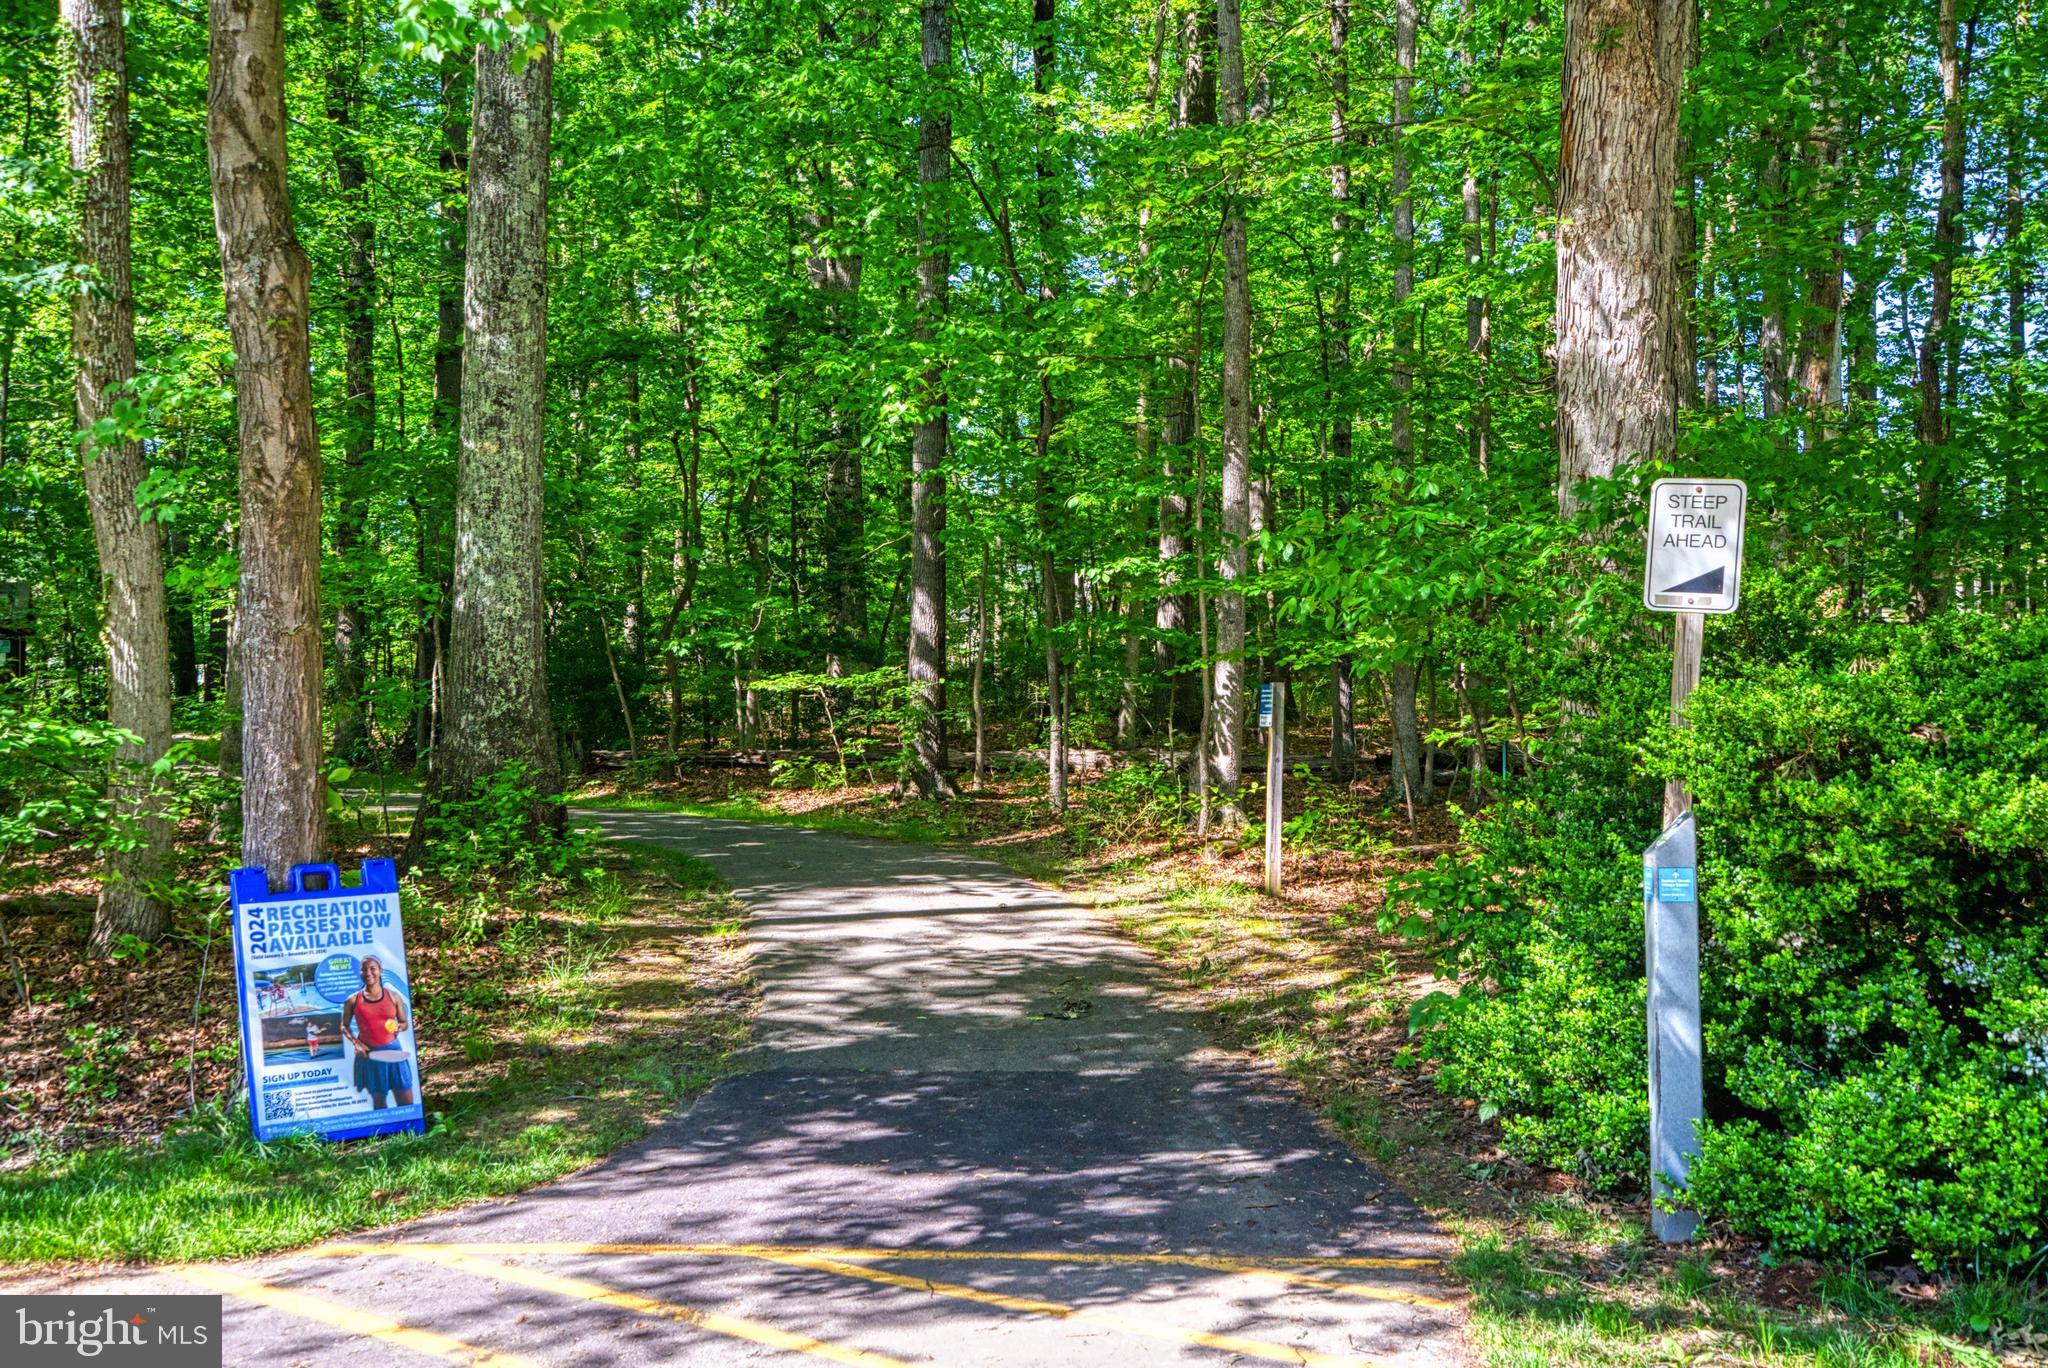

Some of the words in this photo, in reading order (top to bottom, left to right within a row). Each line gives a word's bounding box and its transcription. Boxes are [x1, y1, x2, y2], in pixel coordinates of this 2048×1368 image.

[1668, 494, 1728, 509] STEEP
[1671, 514, 1722, 529] TRAIL
[1663, 533, 1727, 549] AHEAD
[266, 899, 388, 921] RECREATION
[247, 907, 267, 954] 2024
[268, 917, 341, 937] PASSES
[346, 913, 391, 930] NOW
[269, 930, 373, 953] AVAILABLE
[262, 1074, 286, 1083] SIGN
[287, 1072, 300, 1081] UP
[301, 1068, 332, 1078] TODAY
